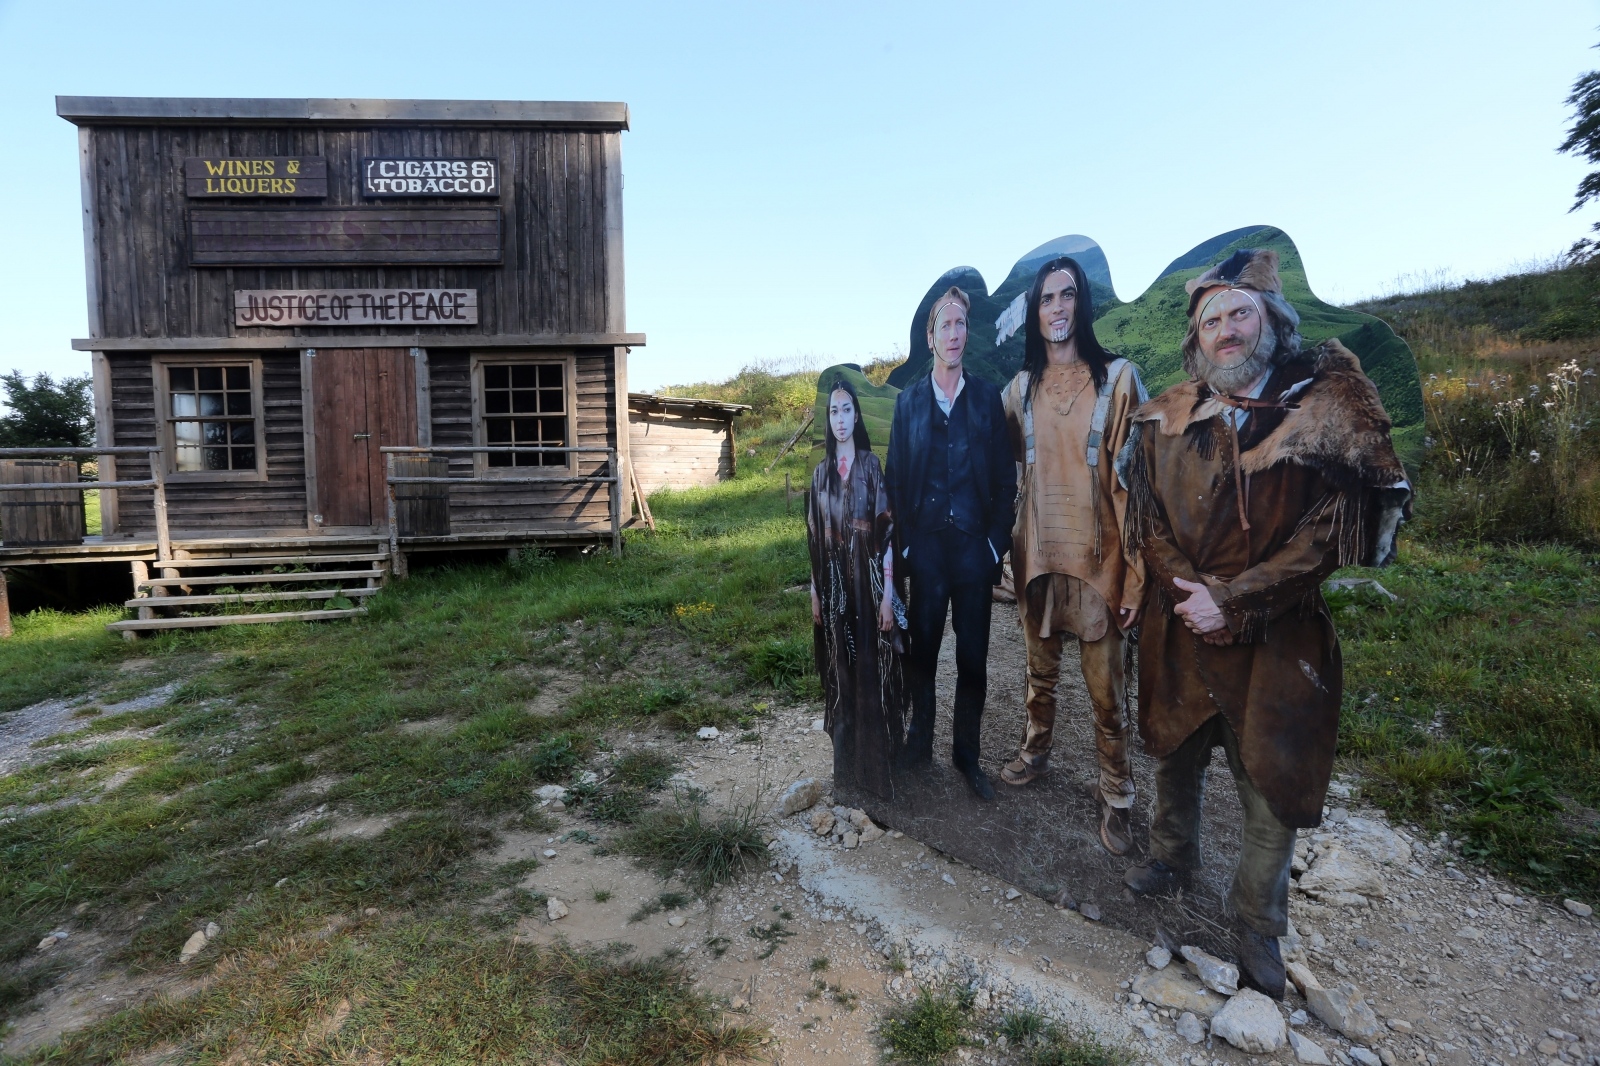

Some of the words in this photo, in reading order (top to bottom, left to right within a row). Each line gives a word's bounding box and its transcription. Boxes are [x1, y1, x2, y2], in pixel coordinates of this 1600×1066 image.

[203, 160, 275, 176] WINES
[286, 160, 300, 174] &
[379, 161, 468, 177] CIGARS
[471, 161, 489, 177] &
[206, 178, 296, 194] LIQUERS
[374, 178, 486, 193] TOBACCO
[240, 294, 329, 322] JUSTICE
[330, 295, 354, 321] OF
[357, 293, 396, 321] THE
[397, 291, 468, 321] PEACE
